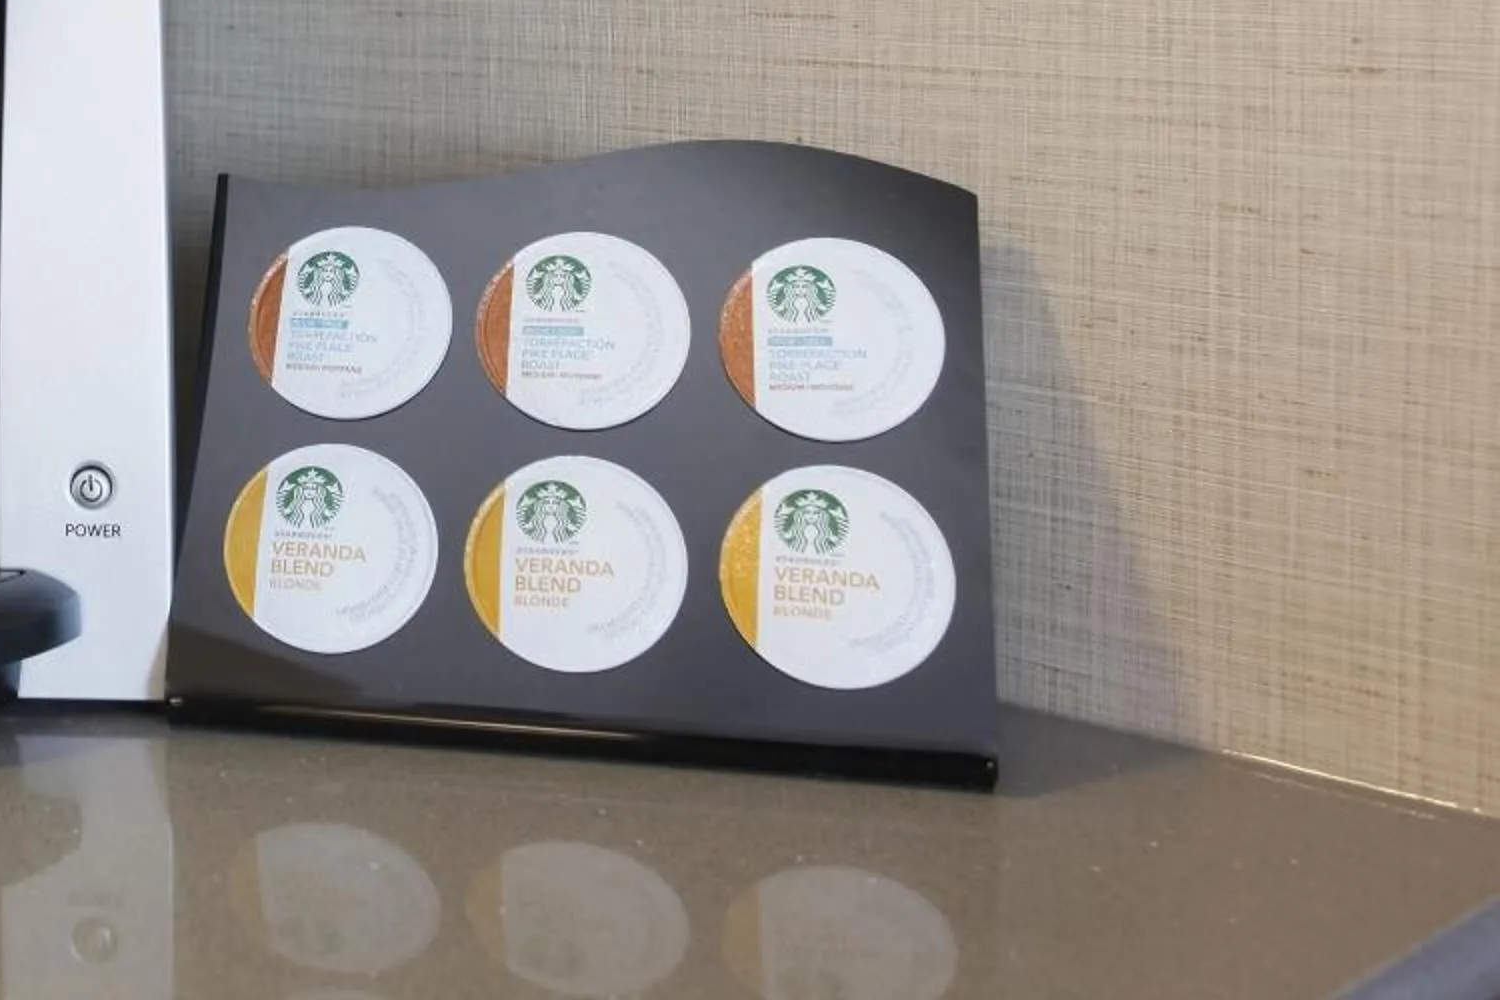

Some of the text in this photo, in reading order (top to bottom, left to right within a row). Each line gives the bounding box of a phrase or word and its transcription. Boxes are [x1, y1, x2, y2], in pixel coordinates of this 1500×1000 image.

[65, 523, 121, 538] POWER
[272, 541, 367, 563] VERANDA
[271, 558, 335, 577] BLEND
[514, 556, 615, 576] VERANDA
[515, 575, 582, 593] BLEND
[774, 565, 881, 589] VERANDA
[773, 584, 845, 605] BLEND
